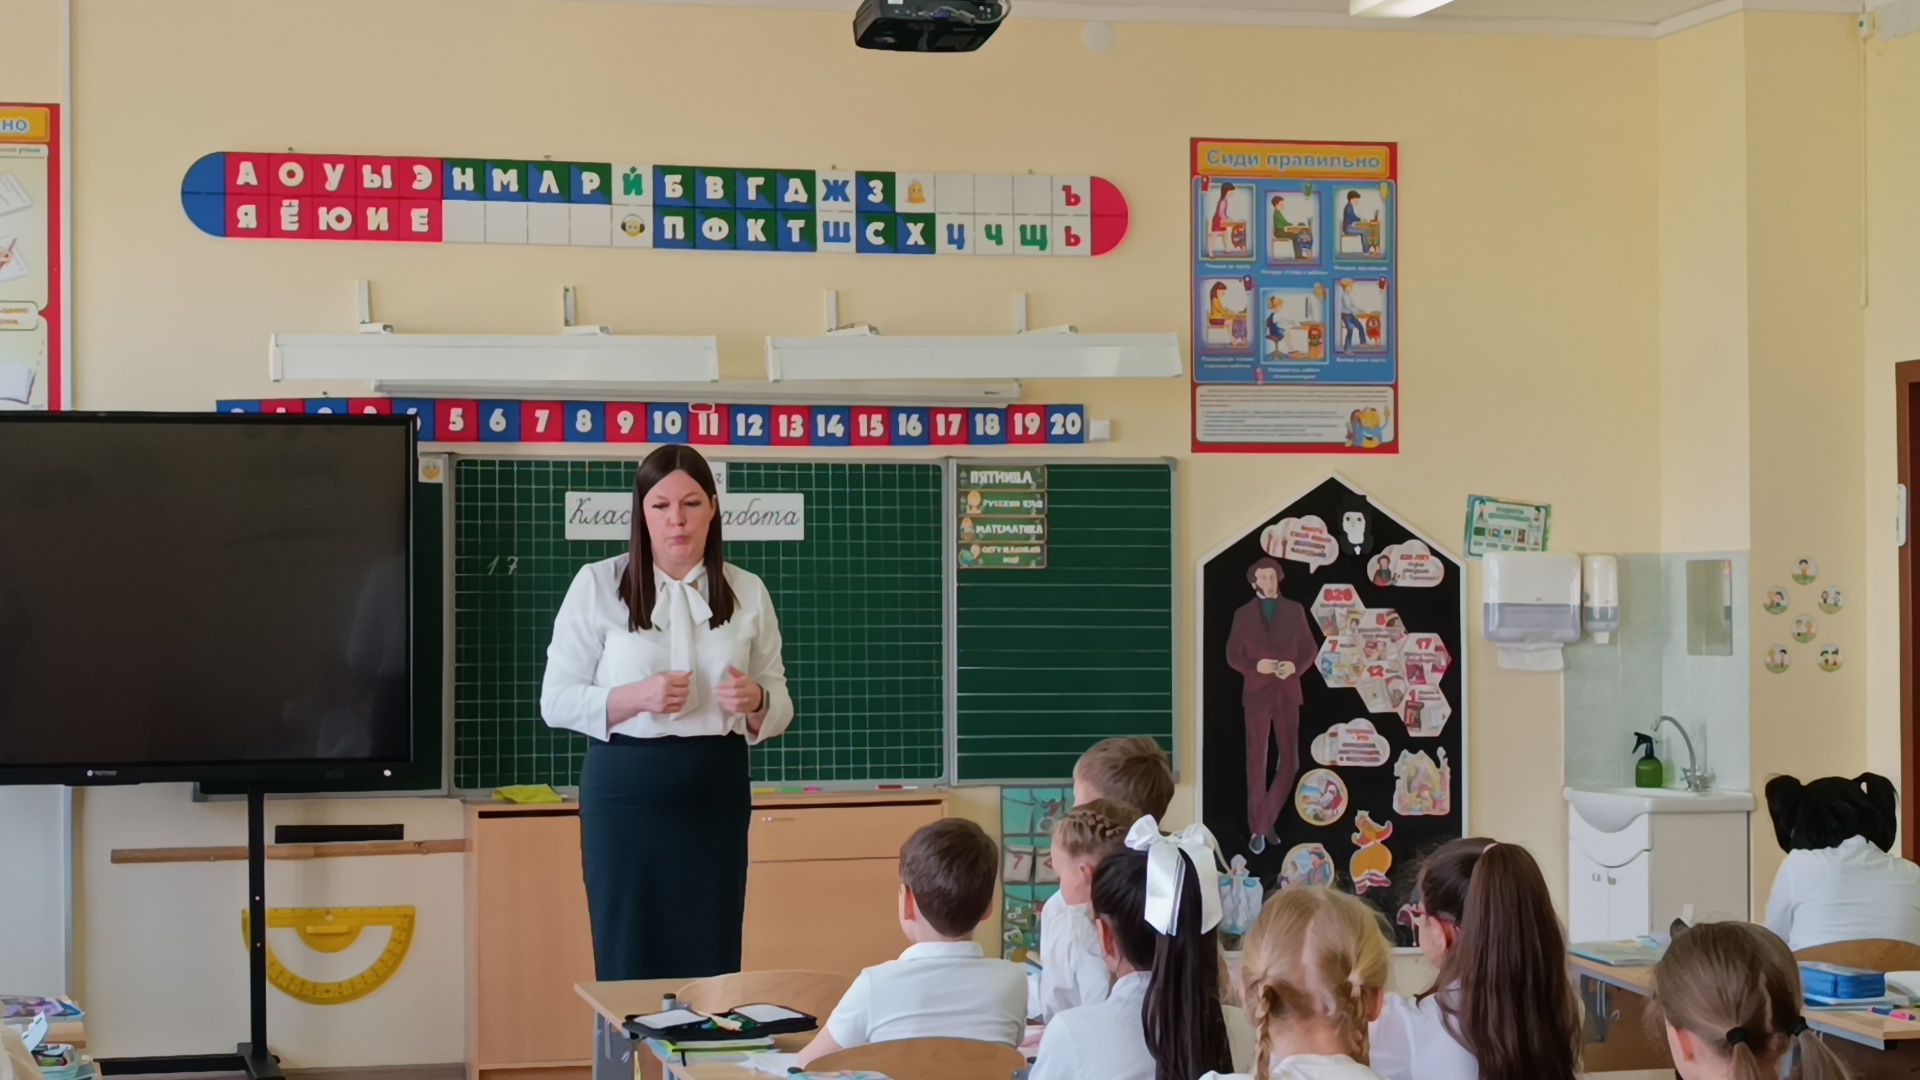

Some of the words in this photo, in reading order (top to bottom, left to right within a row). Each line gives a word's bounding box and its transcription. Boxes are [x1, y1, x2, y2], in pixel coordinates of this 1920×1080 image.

[1206, 150, 1259, 169] Сиди
[1266, 154, 1381, 172] правильно
[236, 161, 258, 186] А
[278, 161, 304, 187] О
[323, 163, 345, 192] У
[362, 164, 393, 189] Ы
[412, 164, 433, 190] Э
[452, 167, 475, 192] Н
[492, 168, 519, 193] М
[539, 170, 560, 194] Л
[581, 171, 601, 195] Р
[623, 166, 644, 197] Й
[664, 174, 683, 198] Б
[705, 175, 724, 200] В
[746, 176, 765, 201] Г
[784, 178, 808, 203] Д
[822, 179, 850, 203] Ж
[867, 179, 884, 204] З
[1062, 184, 1084, 207] Ъ
[236, 204, 258, 229] Я
[280, 199, 299, 231] Ё
[318, 206, 353, 231] Ю
[366, 207, 389, 231] И
[410, 207, 430, 233] Е
[663, 215, 685, 240] П
[701, 217, 729, 241] Ф
[746, 218, 767, 242] К
[786, 219, 806, 243] Т
[823, 220, 851, 244] Ш
[865, 221, 885, 246] С
[906, 222, 925, 246] Х
[947, 223, 966, 250] Ц
[985, 223, 1004, 246] Ч
[1020, 223, 1049, 251] Щ
[1064, 225, 1084, 248] Ь
[448, 408, 464, 431] 5
[489, 408, 507, 432] 6
[534, 409, 550, 433] 7
[575, 409, 593, 433] 8
[617, 410, 634, 434] 9
[653, 410, 682, 435] 10
[698, 412, 719, 436] 11
[736, 413, 763, 437] 12
[778, 414, 804, 438] 13
[816, 414, 845, 438] 14
[858, 414, 884, 437] 15
[898, 413, 923, 437] 16
[936, 413, 962, 436] 17
[975, 413, 1000, 436] 18
[1014, 412, 1041, 435] 19
[1050, 412, 1082, 435] 20
[970, 470, 1033, 484] ПЯТНИЦА
[721, 497, 801, 526] абота
